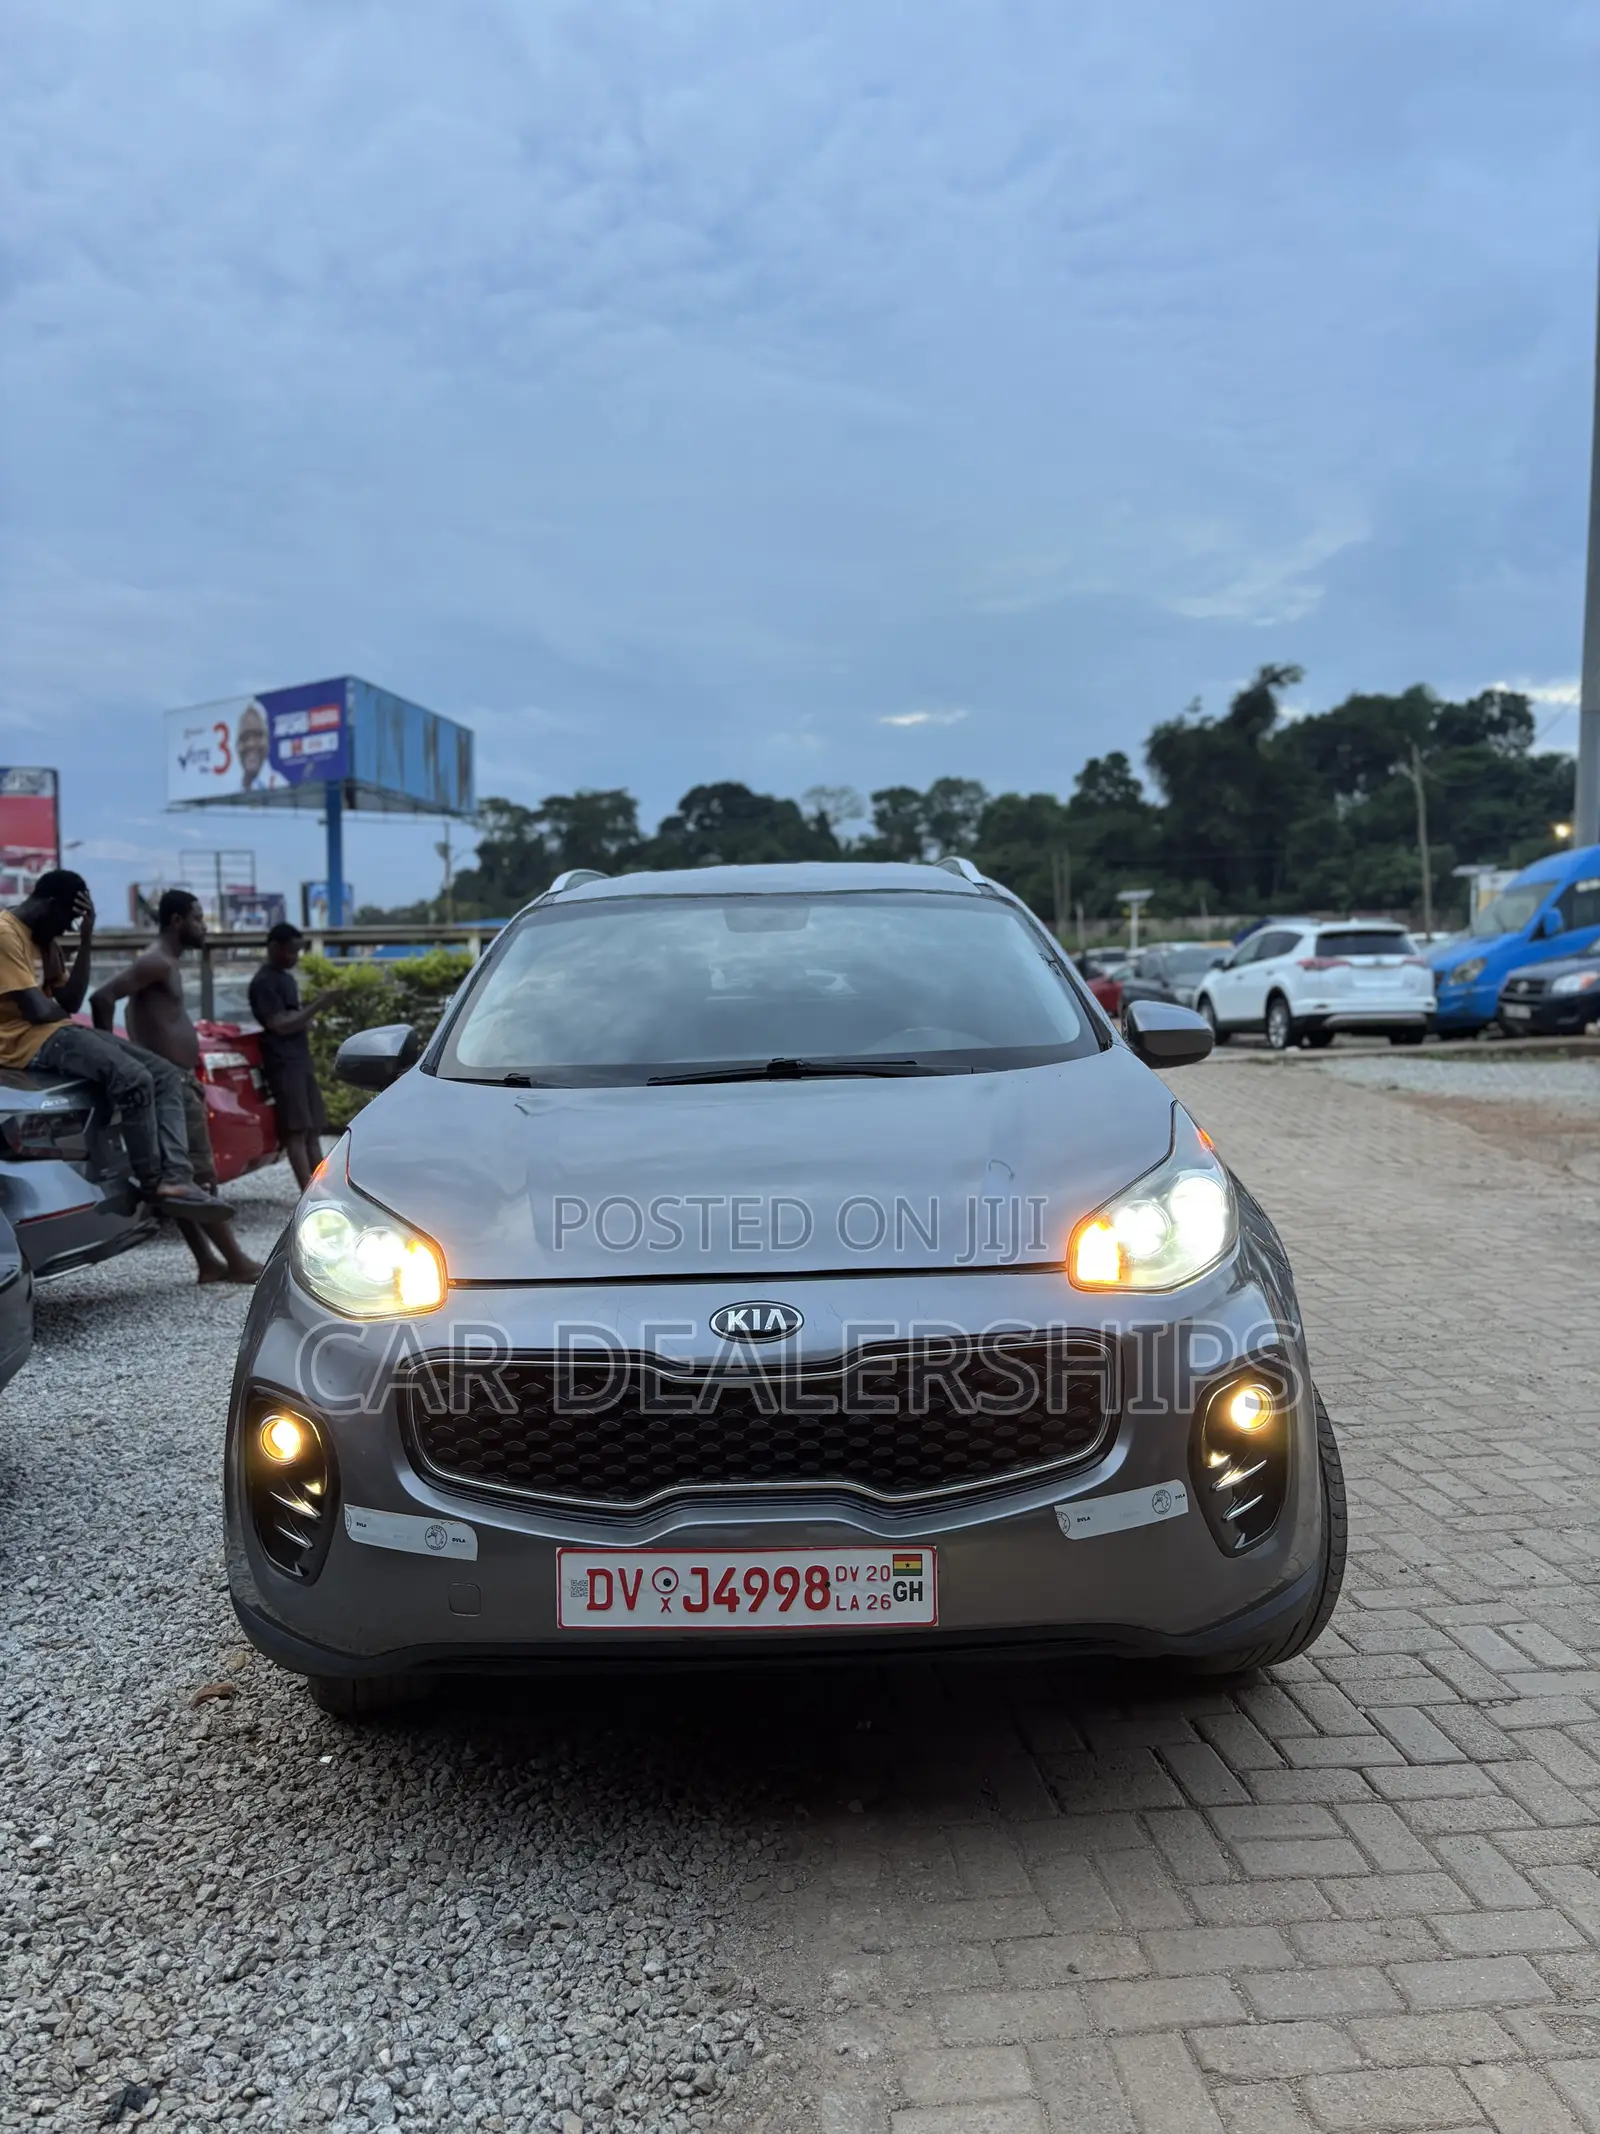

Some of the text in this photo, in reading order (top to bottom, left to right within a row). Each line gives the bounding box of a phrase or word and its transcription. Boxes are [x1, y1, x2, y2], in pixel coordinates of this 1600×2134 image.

[727, 1308, 788, 1332] KIA
[835, 1565, 891, 1582] DV 20
[586, 1564, 831, 1614] DV J4998
[892, 1580, 923, 1602] GH
[835, 1594, 892, 1611] LA 26
